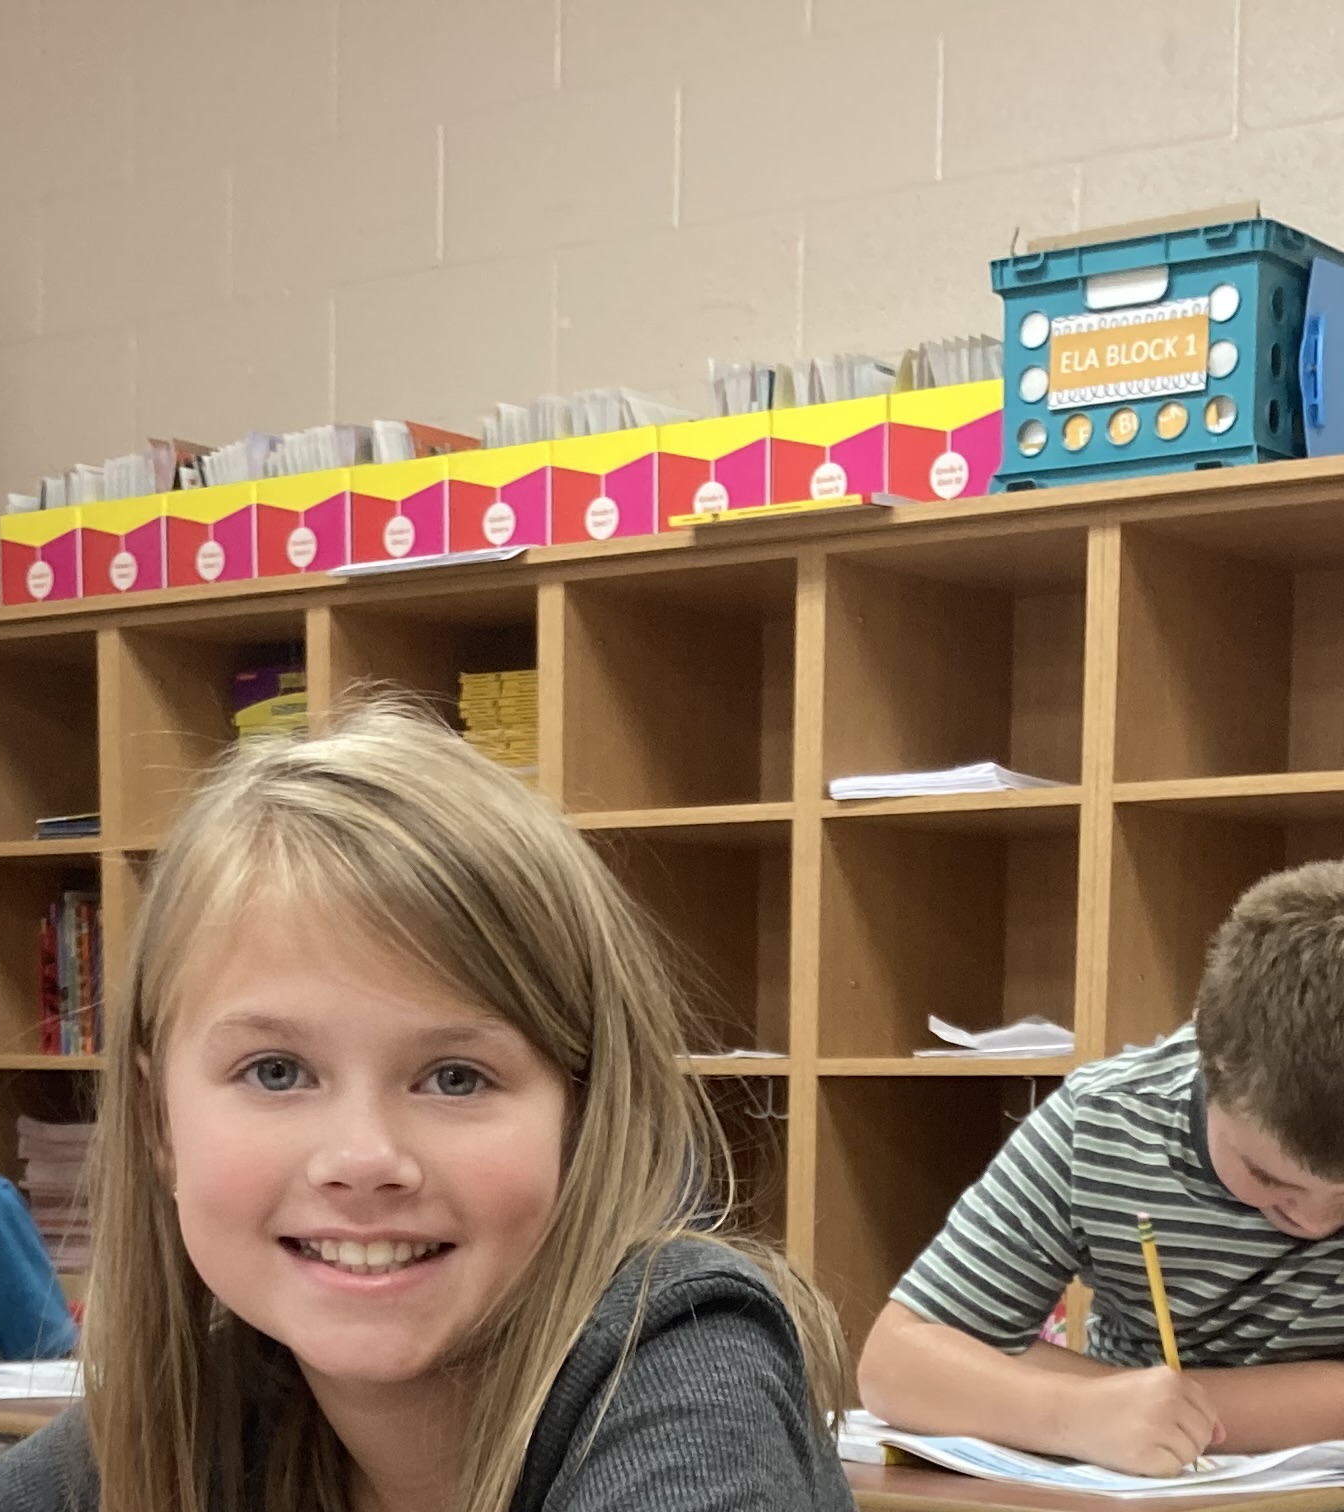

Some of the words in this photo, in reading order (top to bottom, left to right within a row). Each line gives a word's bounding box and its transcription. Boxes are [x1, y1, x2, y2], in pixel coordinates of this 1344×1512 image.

[1059, 347, 1099, 374] ELA
[1106, 338, 1179, 367] BLOCK
[1186, 333, 1198, 356] 1
